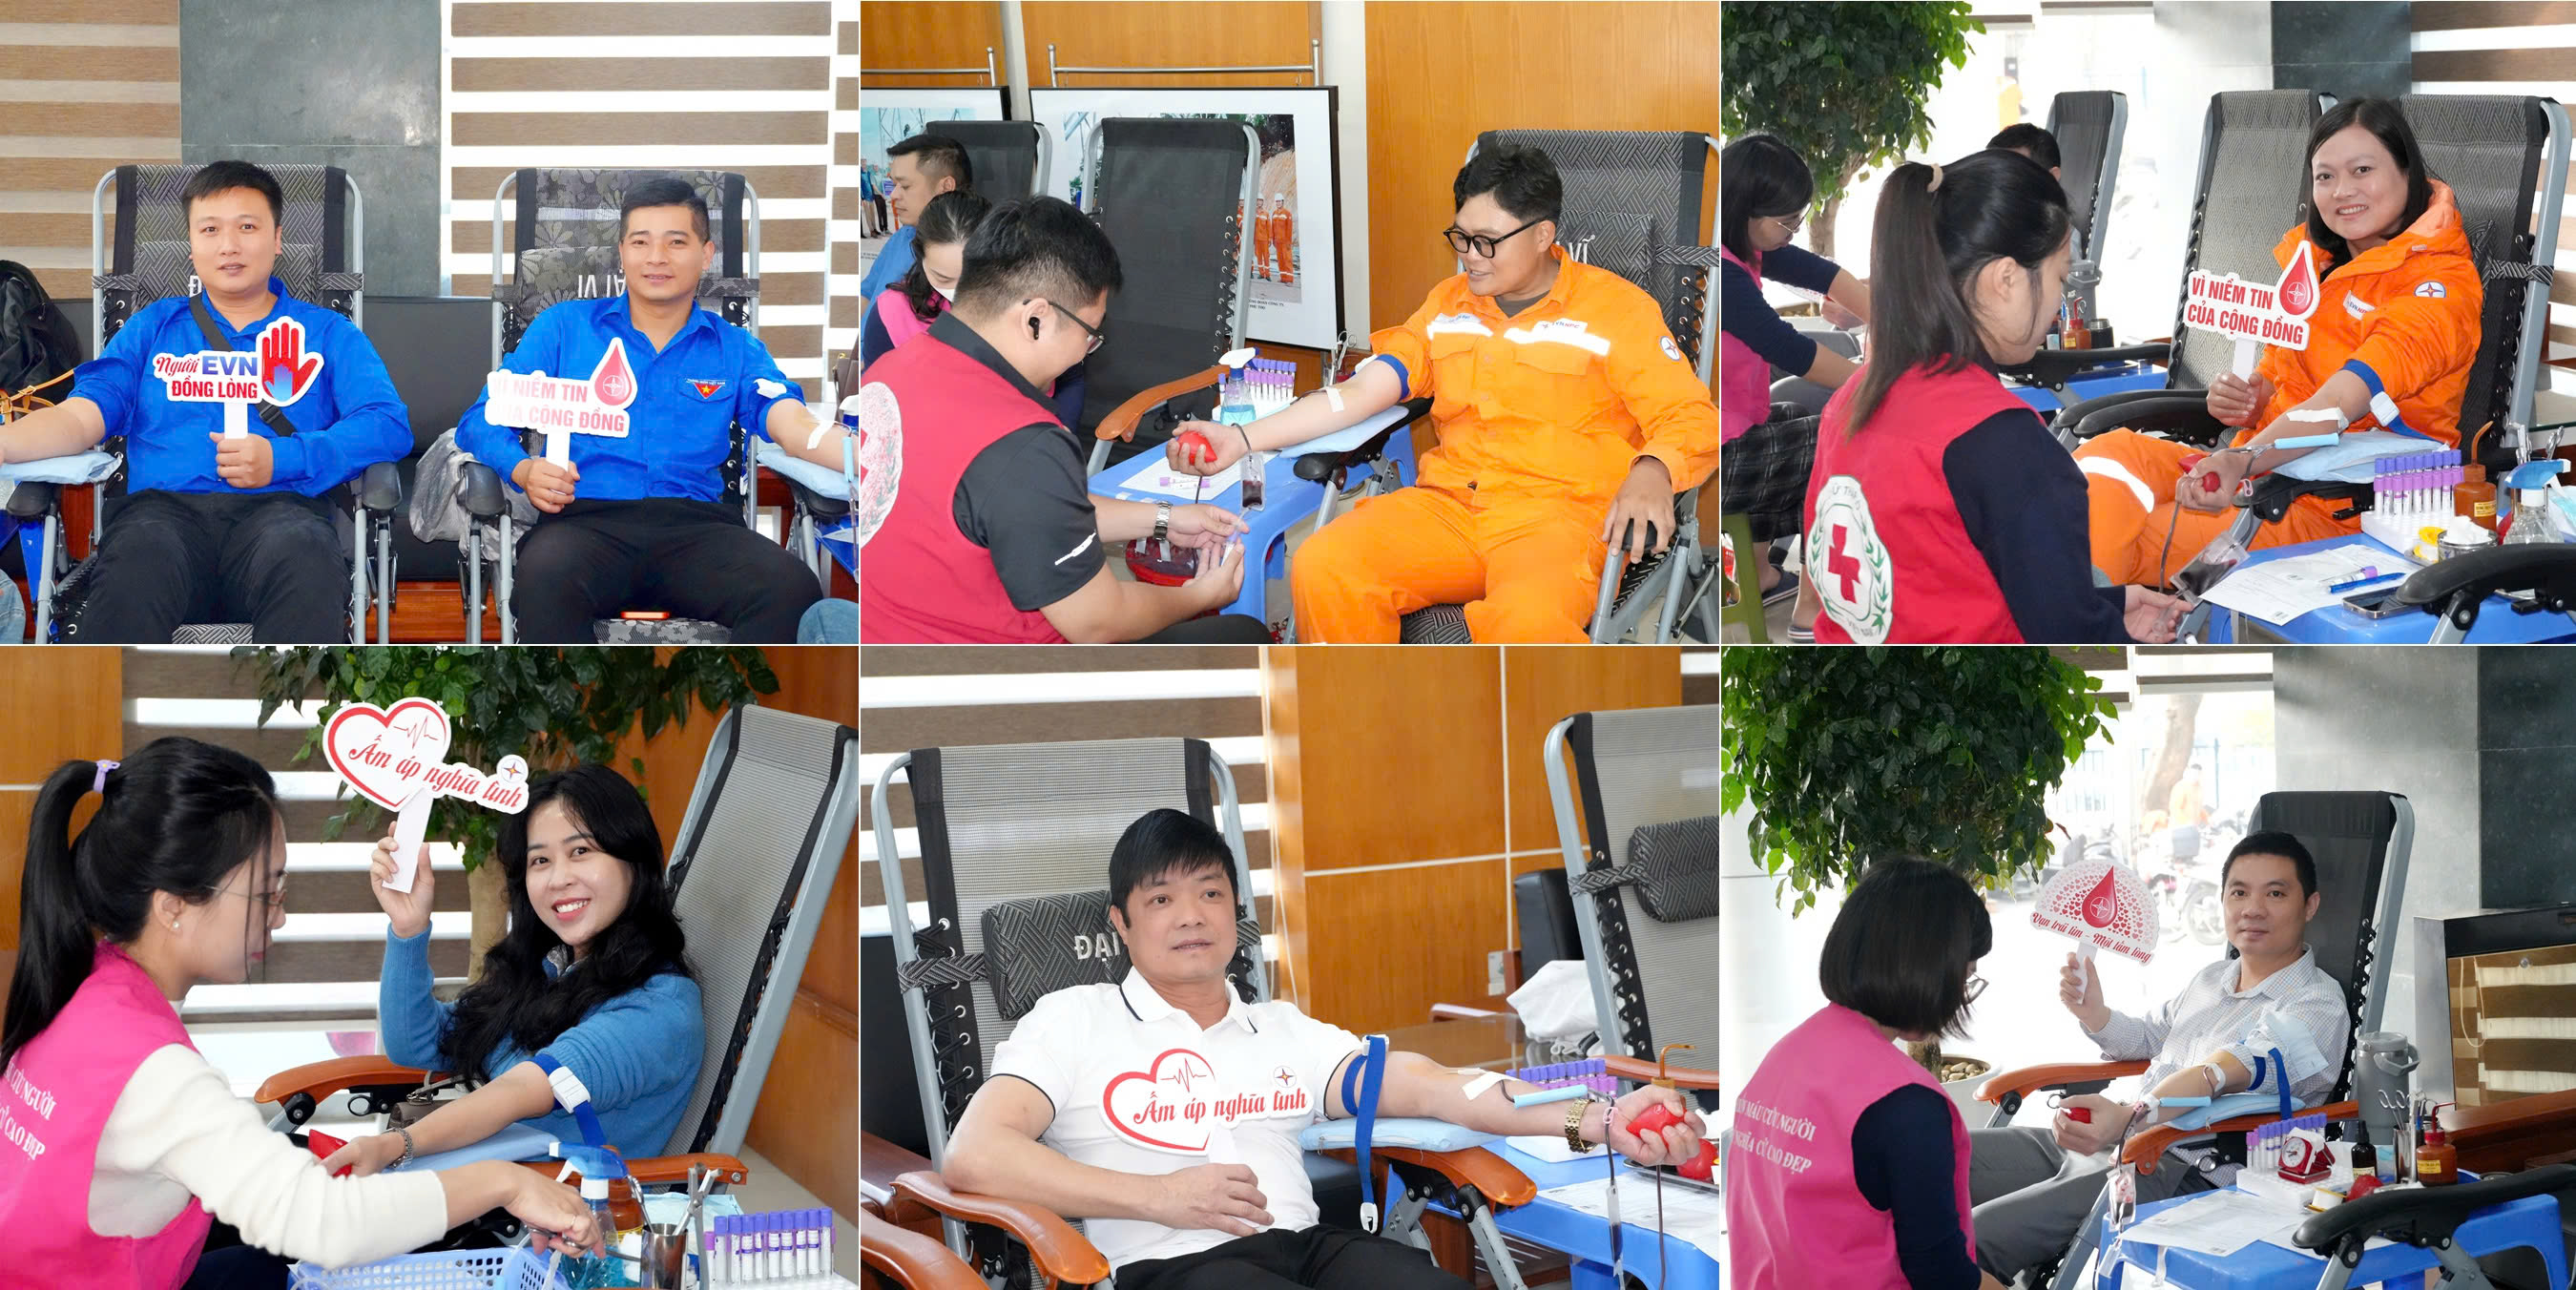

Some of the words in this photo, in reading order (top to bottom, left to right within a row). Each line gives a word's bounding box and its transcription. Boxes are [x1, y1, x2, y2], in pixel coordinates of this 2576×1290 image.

[2192, 275, 2205, 297] VÌ
[2209, 278, 2246, 304] NIỀM
[2250, 288, 2274, 310] TIN
[2188, 301, 2214, 326] CỦA
[2219, 309, 2258, 335] CỘNG
[2262, 316, 2303, 344] ĐỒNG
[156, 357, 200, 376] Người
[201, 356, 258, 376] EVN
[172, 376, 214, 397] ĐỒNG
[218, 378, 258, 399] LÒNG
[513, 376, 556, 400] NIỀM
[561, 384, 588, 403] TIN
[529, 405, 573, 428] CỘNG
[578, 407, 625, 432] ĐỒNG
[348, 734, 392, 769] Ấm
[395, 755, 422, 780] áp
[423, 766, 480, 794] nghĩa
[2032, 912, 2050, 927] Vạn
[2051, 920, 2069, 933] trái
[2068, 926, 2084, 939] tim
[2092, 932, 2113, 949] Một
[1074, 931, 1121, 962] ĐẠI
[1132, 1091, 1175, 1124] Ấm
[1184, 1097, 1207, 1124] áp
[1214, 1092, 1266, 1123] nghĩa
[4, 1116, 26, 1146] CAO
[1776, 1113, 1817, 1142] NGƯỜI
[1781, 1150, 1812, 1175] ĐẸP
